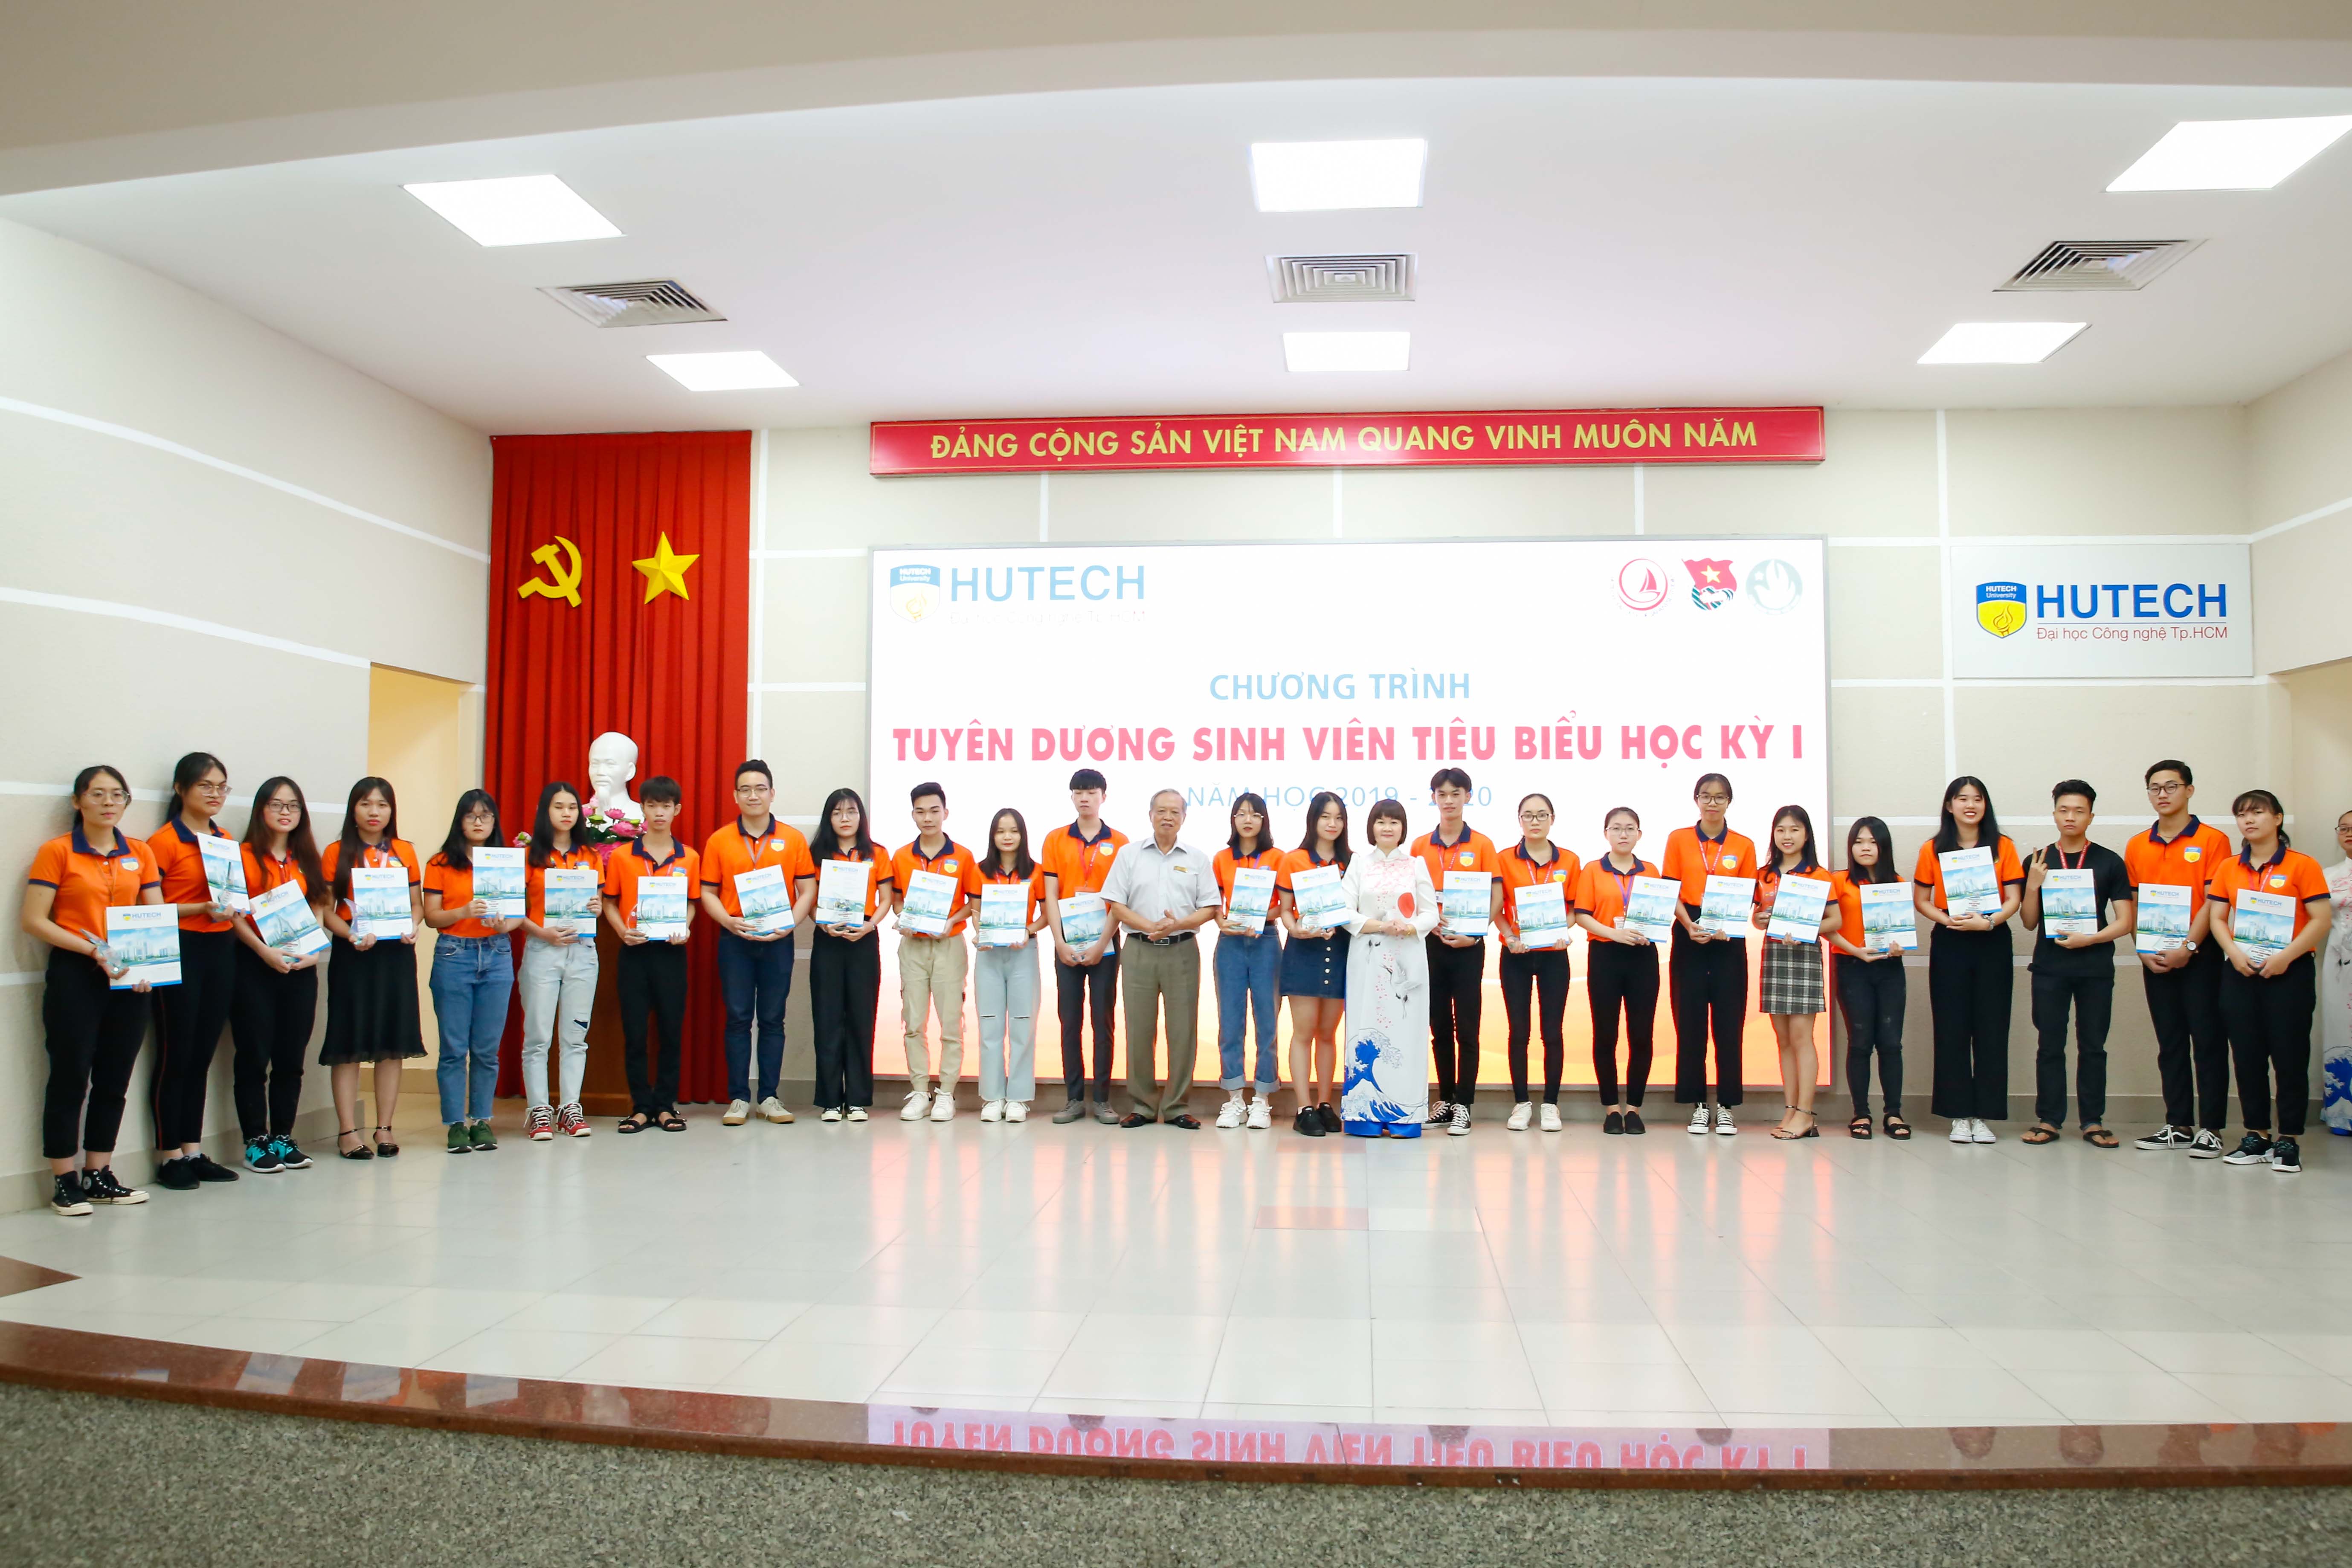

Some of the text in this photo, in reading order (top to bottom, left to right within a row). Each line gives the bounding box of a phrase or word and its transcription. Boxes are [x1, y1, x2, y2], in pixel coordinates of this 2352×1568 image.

[931, 417, 1757, 461] ĐẢNG CỘNG SẢN VIỆT NAM QUANG VINH MUÔN NĂM
[951, 565, 1144, 602] HUTECH
[2036, 583, 2227, 618] HUTECH
[2036, 626, 2227, 641] Đại học Công nghệ Tp.HCM
[1209, 668, 1470, 700] CHƯƠNG TRÌNH
[893, 710, 1802, 769] TUYÊN DƯƠNG SINH VIÊN TIÊU BIỂU HỌC KỲ I
